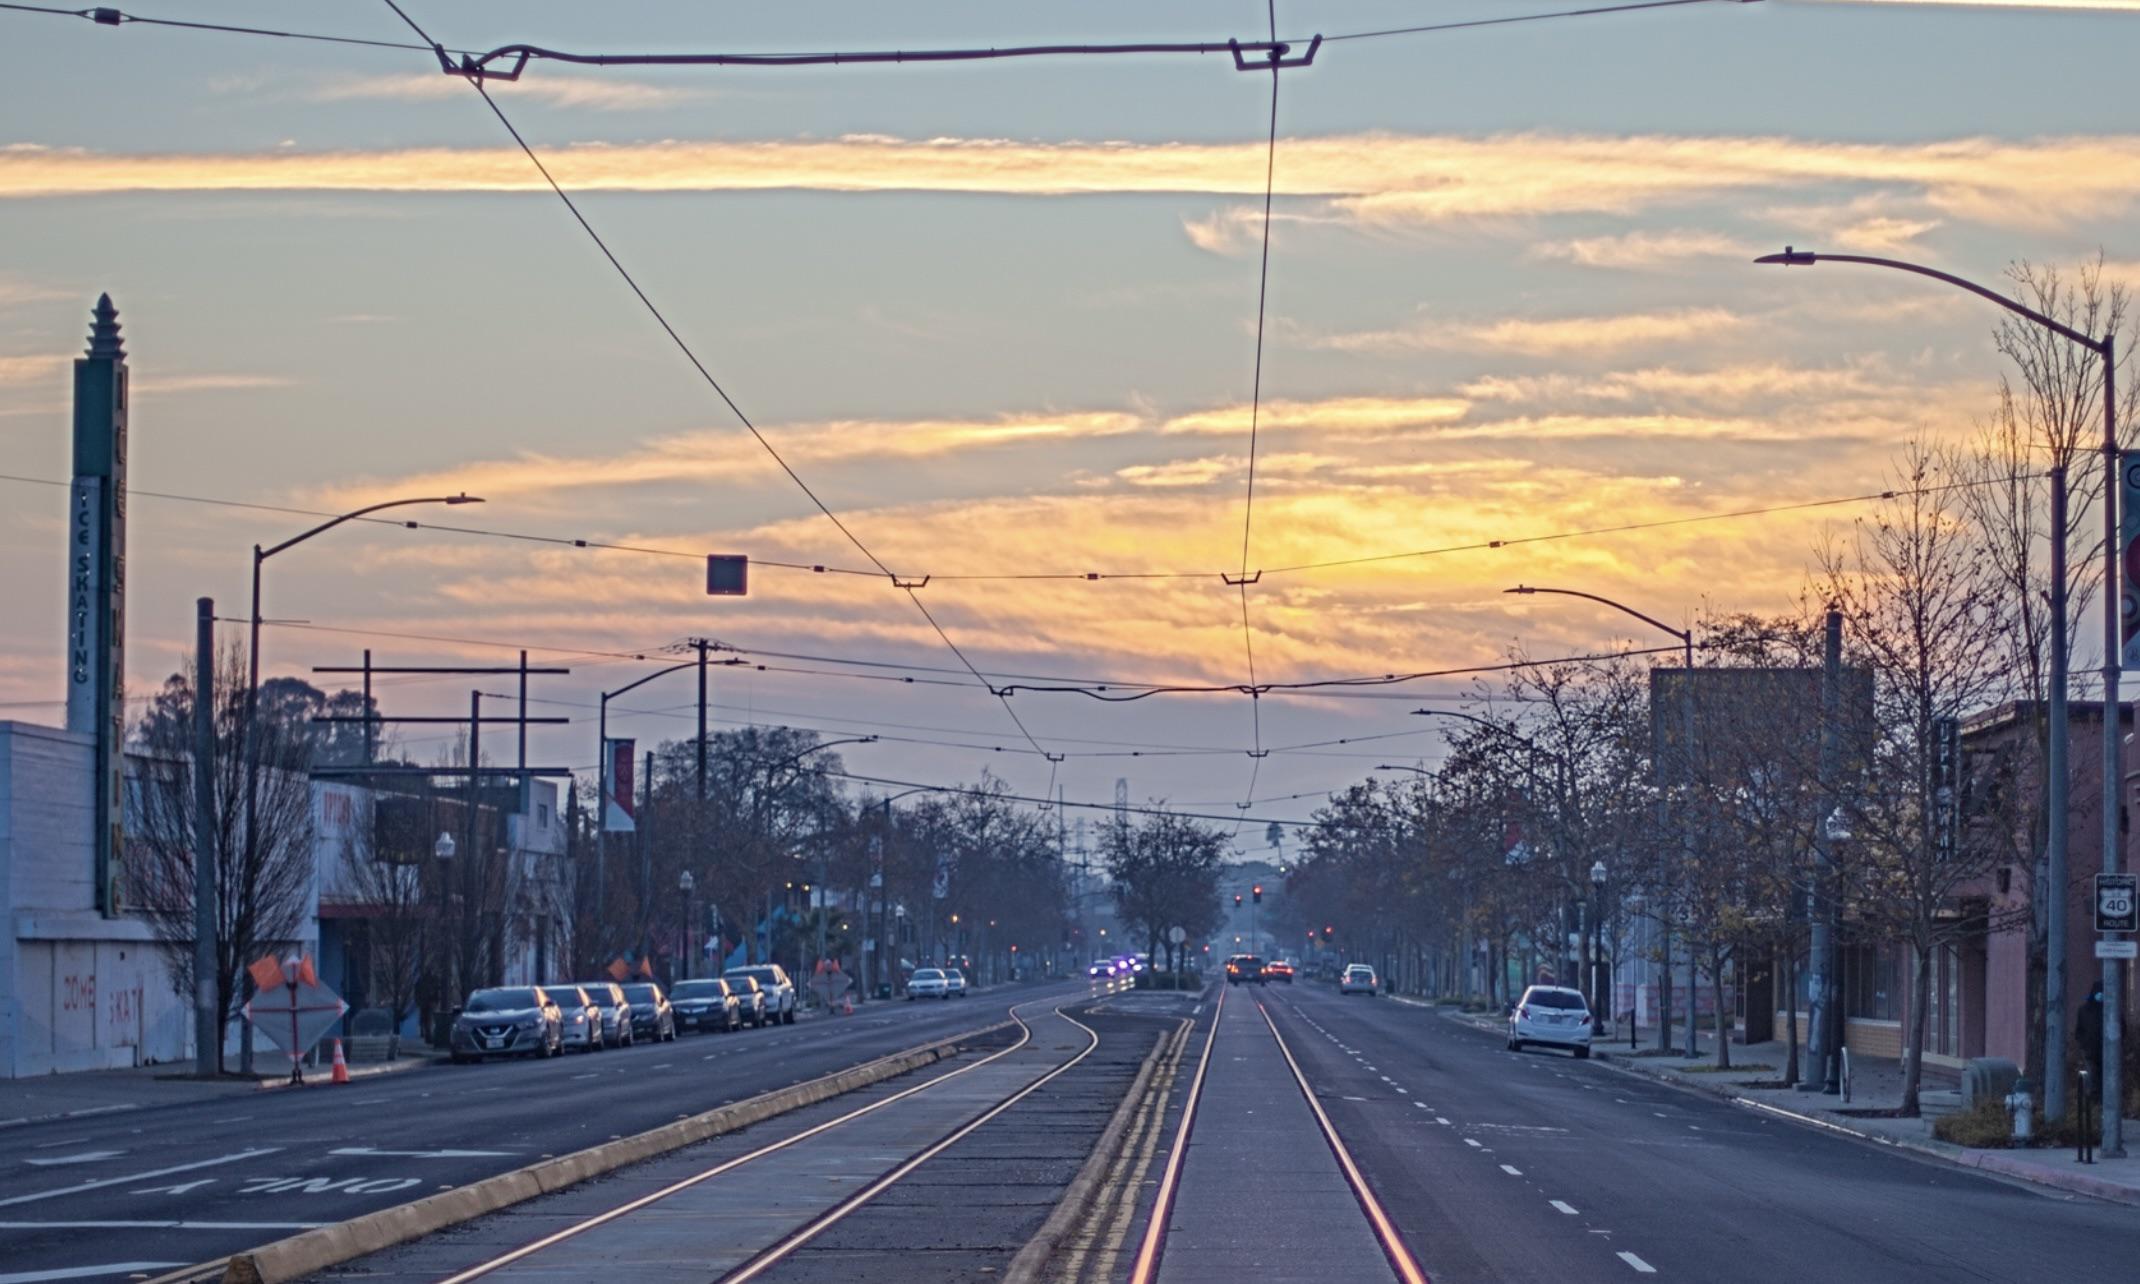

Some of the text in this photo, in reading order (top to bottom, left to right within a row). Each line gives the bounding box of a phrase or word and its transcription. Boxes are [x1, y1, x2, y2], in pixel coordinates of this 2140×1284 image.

[73, 491, 90, 684] ICE SKATING
[2105, 899, 2127, 912] 40
[2103, 919, 2130, 928] ROUTE
